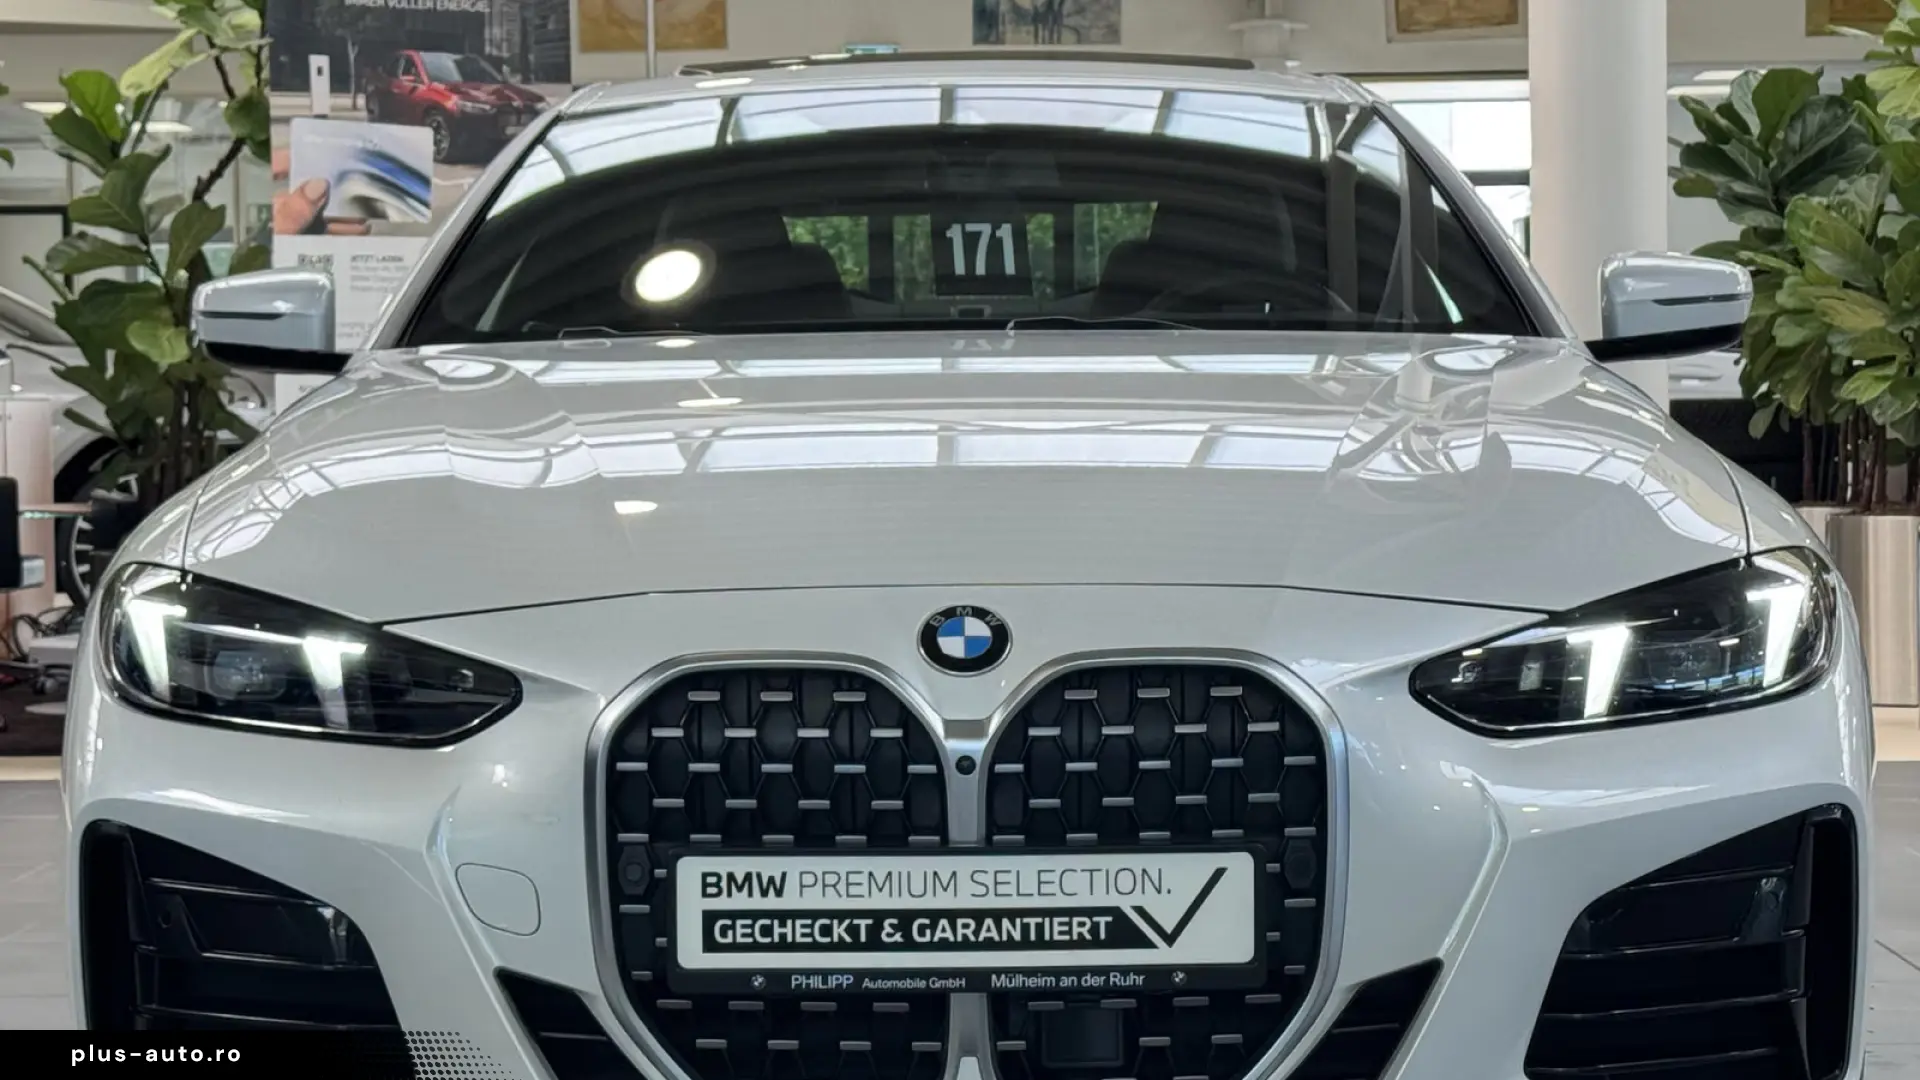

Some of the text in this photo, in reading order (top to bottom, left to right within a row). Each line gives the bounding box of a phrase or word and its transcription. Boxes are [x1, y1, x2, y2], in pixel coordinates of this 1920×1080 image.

[945, 223, 1016, 275] 171
[929, 606, 1002, 627] BMW
[701, 867, 1172, 898] BMW PREMIUM SELECTION.
[713, 916, 1113, 943] GECHECKT & GARANTIERT
[791, 972, 1146, 990] PHILIPP Automobile GmbH Mülheim an der Ruhr
